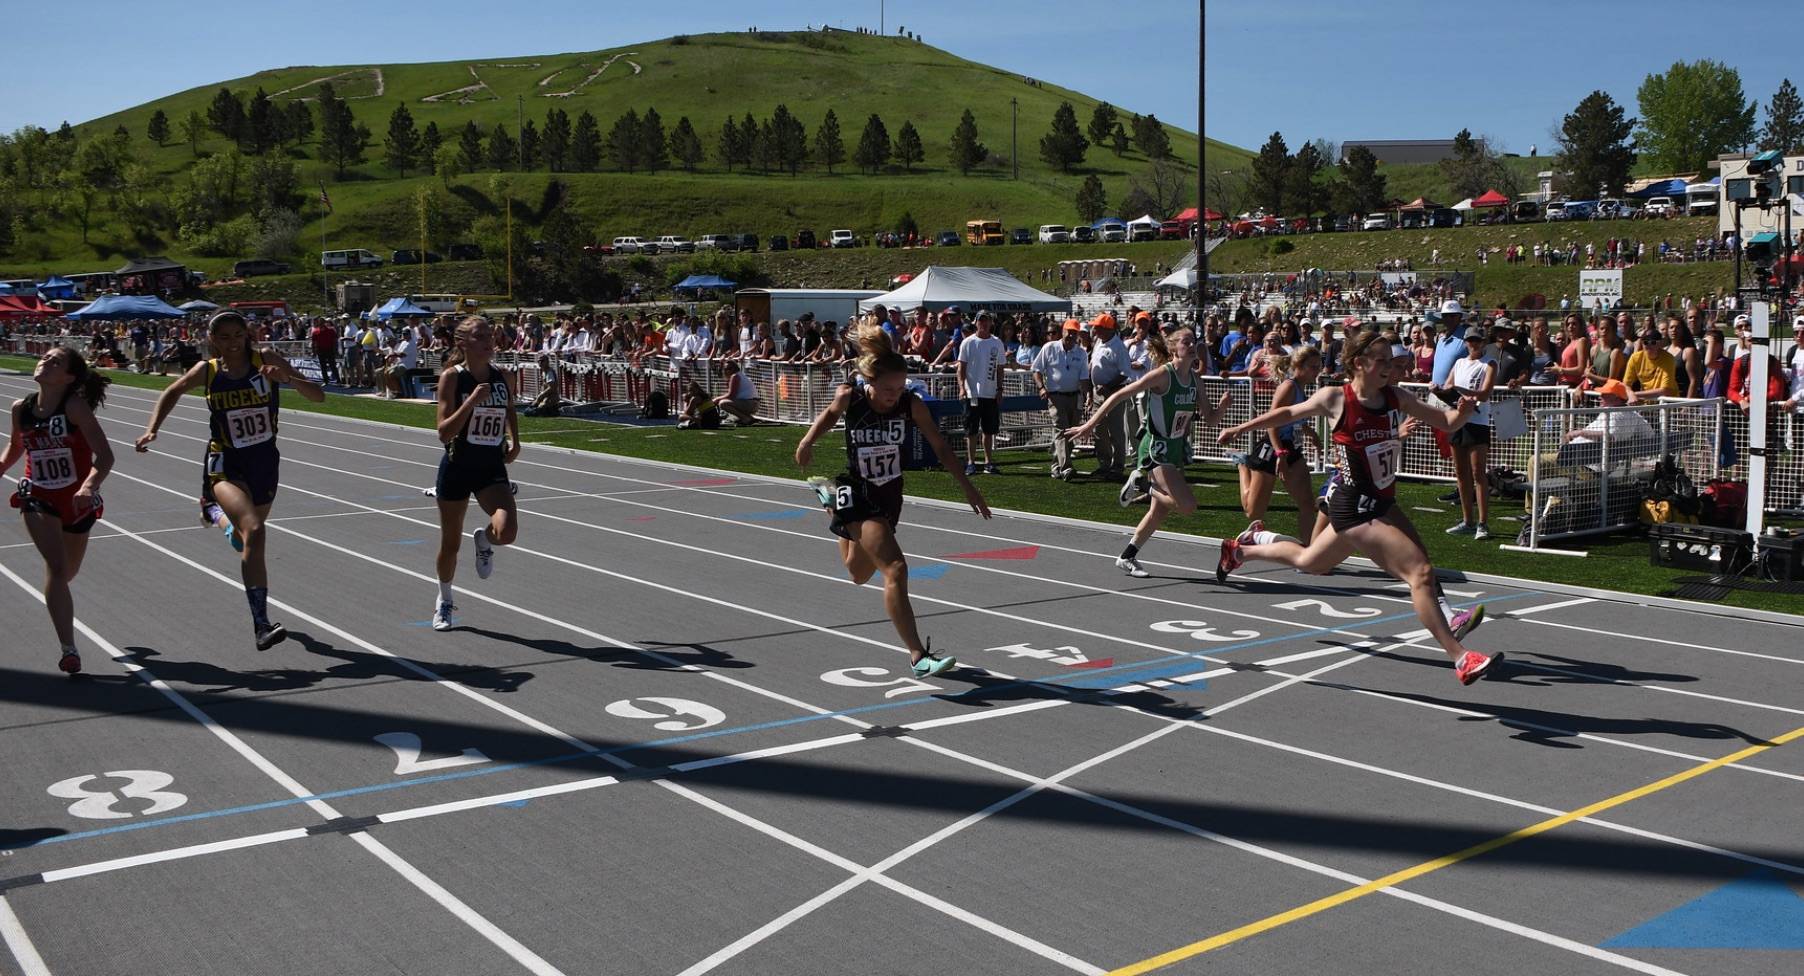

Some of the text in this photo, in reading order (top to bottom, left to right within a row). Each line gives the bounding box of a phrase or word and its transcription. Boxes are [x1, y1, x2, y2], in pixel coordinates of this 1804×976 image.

[496, 384, 507, 400] 6
[51, 417, 64, 436] 8
[232, 413, 267, 439] 303
[472, 415, 501, 437] 166
[890, 420, 902, 442] 5
[1354, 427, 1393, 441] CHEST
[1155, 440, 1166, 456] 2
[34, 457, 71, 480] 108
[209, 453, 221, 472] 7
[863, 453, 897, 479] 157
[1377, 449, 1395, 478] 57
[838, 486, 850, 507] 5
[1270, 599, 1382, 618] 2
[1149, 620, 1261, 641] 3
[983, 643, 1089, 666] 4
[820, 667, 944, 699] 5
[605, 697, 727, 731] 6
[373, 732, 493, 775] 7
[46, 770, 188, 819] 8
